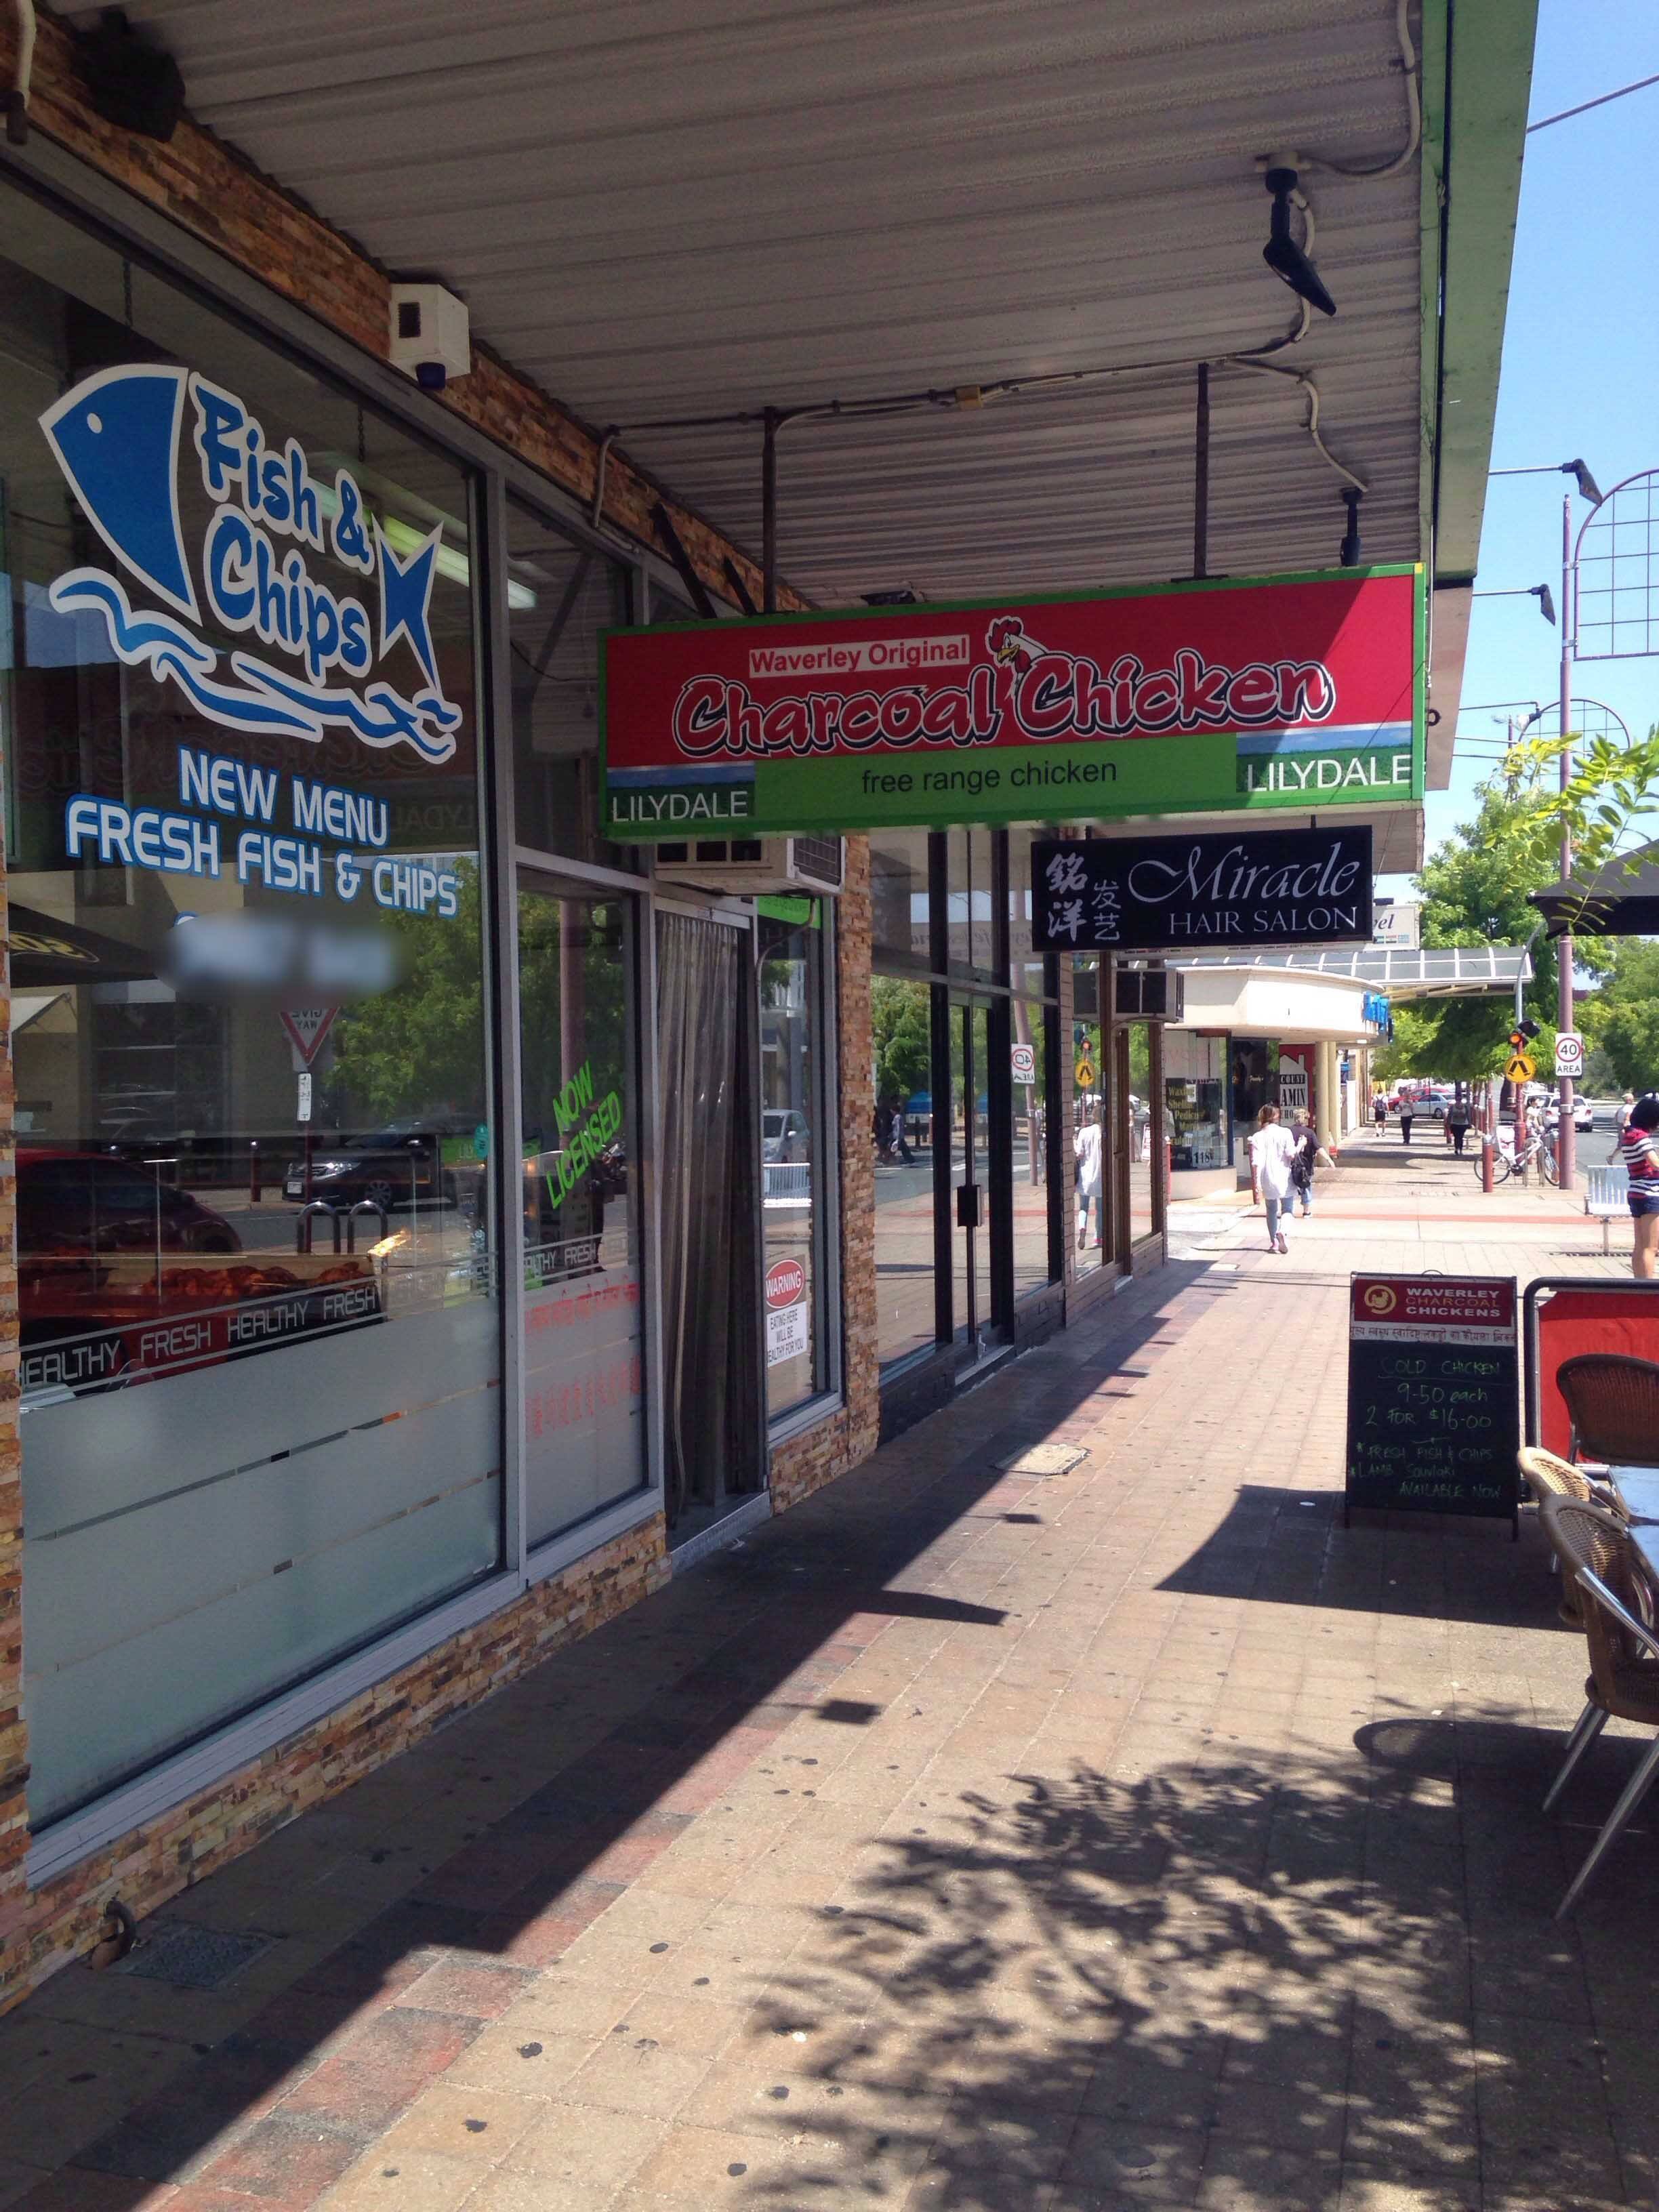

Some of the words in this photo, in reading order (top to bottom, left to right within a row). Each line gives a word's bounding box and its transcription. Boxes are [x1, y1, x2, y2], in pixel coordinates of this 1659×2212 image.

[189, 371, 325, 551] Fish
[331, 469, 375, 575] &
[204, 504, 371, 686] Chips
[750, 646, 862, 673] Waverley
[868, 638, 967, 669] Original
[673, 664, 1004, 758] Charcoal
[1017, 647, 1336, 737] Chicken
[862, 770, 912, 794] free
[923, 769, 1000, 794] range
[1010, 760, 1117, 786] chicken
[1248, 755, 1412, 792] LILYDALE
[178, 747, 281, 824] NEW
[292, 776, 390, 848] MENU
[613, 791, 748, 823] LILYDALE
[66, 794, 221, 878] FRESH
[237, 832, 322, 895] FISH
[335, 850, 361, 902] &
[373, 859, 459, 919] CHIPS
[1128, 842, 1359, 903] Miracle
[1170, 909, 1240, 935] HAIR
[1253, 905, 1357, 932] SALON
[1560, 1044, 1578, 1055] 40
[1557, 1065, 1580, 1073] AREA
[553, 1059, 594, 1137] NOW
[547, 1090, 621, 1210] LICENSED
[766, 1270, 801, 1297] WARNING
[1406, 1288, 1500, 1298] WAVERLEY
[1406, 1297, 1500, 1307] CHARCOAL
[1406, 1307, 1501, 1317] CHICKENS
[140, 1322, 211, 1362] FRESH
[227, 1300, 308, 1343] HEALTHY
[323, 1286, 375, 1320] FRESH
[768, 1344, 785, 1363] EALTHY
[1380, 1357, 1427, 1374] COLD
[1441, 1360, 1500, 1375] CHICKEN
[1450, 1388, 1488, 1404] each
[1366, 1405, 1378, 1426] 2
[1388, 1408, 1416, 1425] FOR
[1399, 1481, 1463, 1498] AVAILABLE
